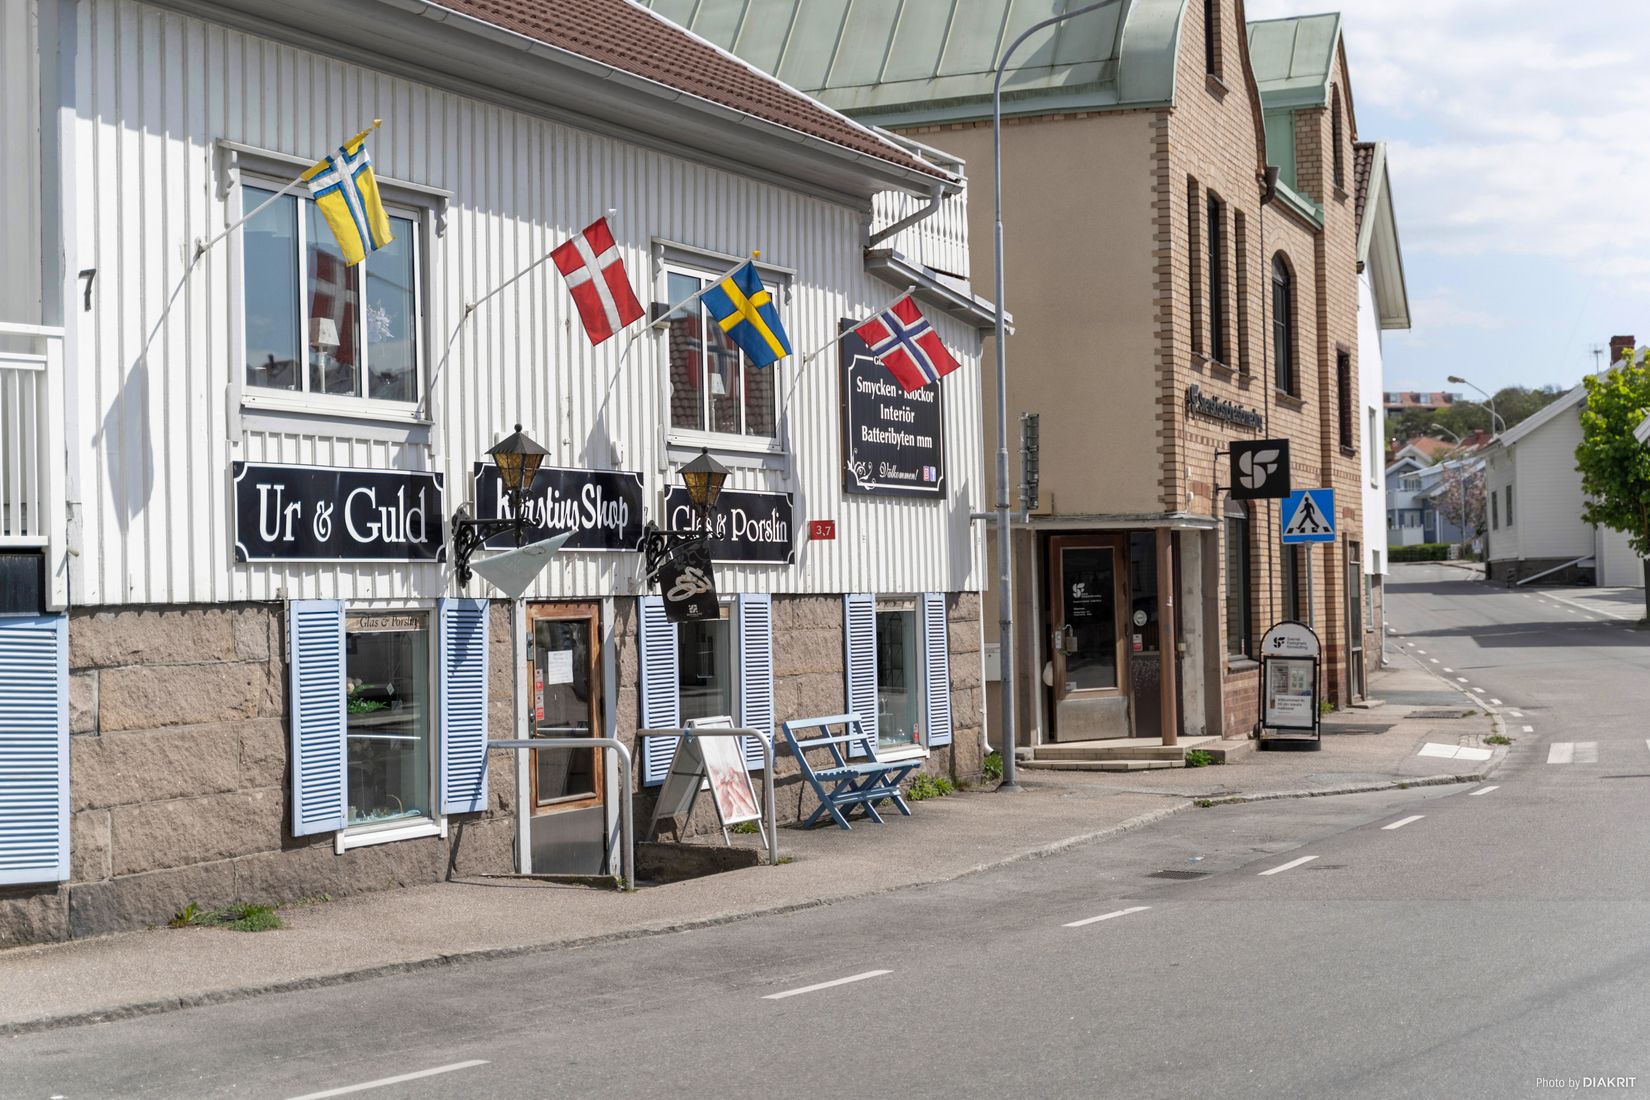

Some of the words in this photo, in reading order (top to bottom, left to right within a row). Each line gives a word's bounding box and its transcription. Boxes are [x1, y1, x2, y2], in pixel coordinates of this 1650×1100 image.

[78, 269, 96, 312] 7
[857, 376, 896, 400] Smycken
[880, 404, 915, 423] Interiör
[862, 426, 915, 450] Batteribyten
[917, 435, 933, 448] mm
[256, 484, 301, 542] Ur
[313, 500, 334, 543] &
[344, 485, 428, 543] Guld
[581, 483, 629, 540] Shop
[730, 506, 788, 543] Porslin
[359, 615, 379, 628] Glas
[381, 616, 389, 627] &
